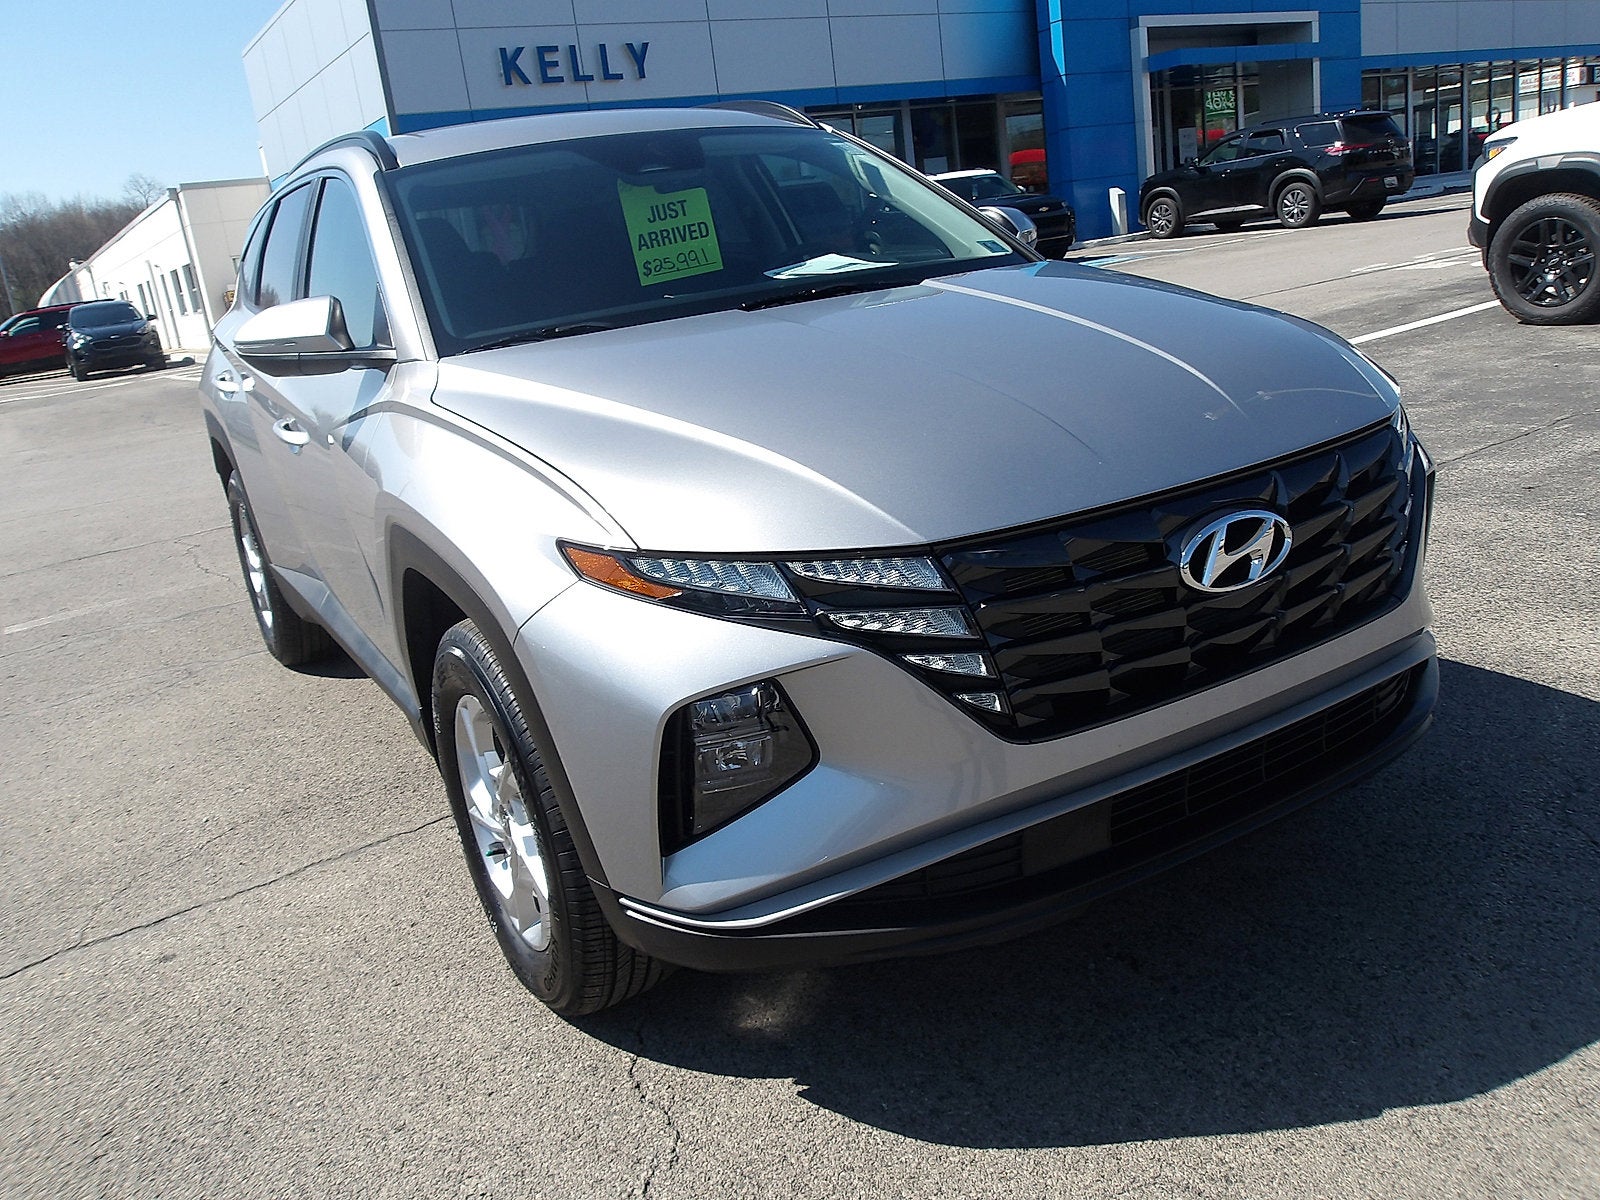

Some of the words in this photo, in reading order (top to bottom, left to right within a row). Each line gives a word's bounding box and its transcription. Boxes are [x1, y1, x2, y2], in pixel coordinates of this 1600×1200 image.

[499, 42, 649, 85] KELLY
[647, 200, 687, 223] JUST
[638, 221, 710, 251] ARRIVED
[642, 248, 708, 277] $25,991
